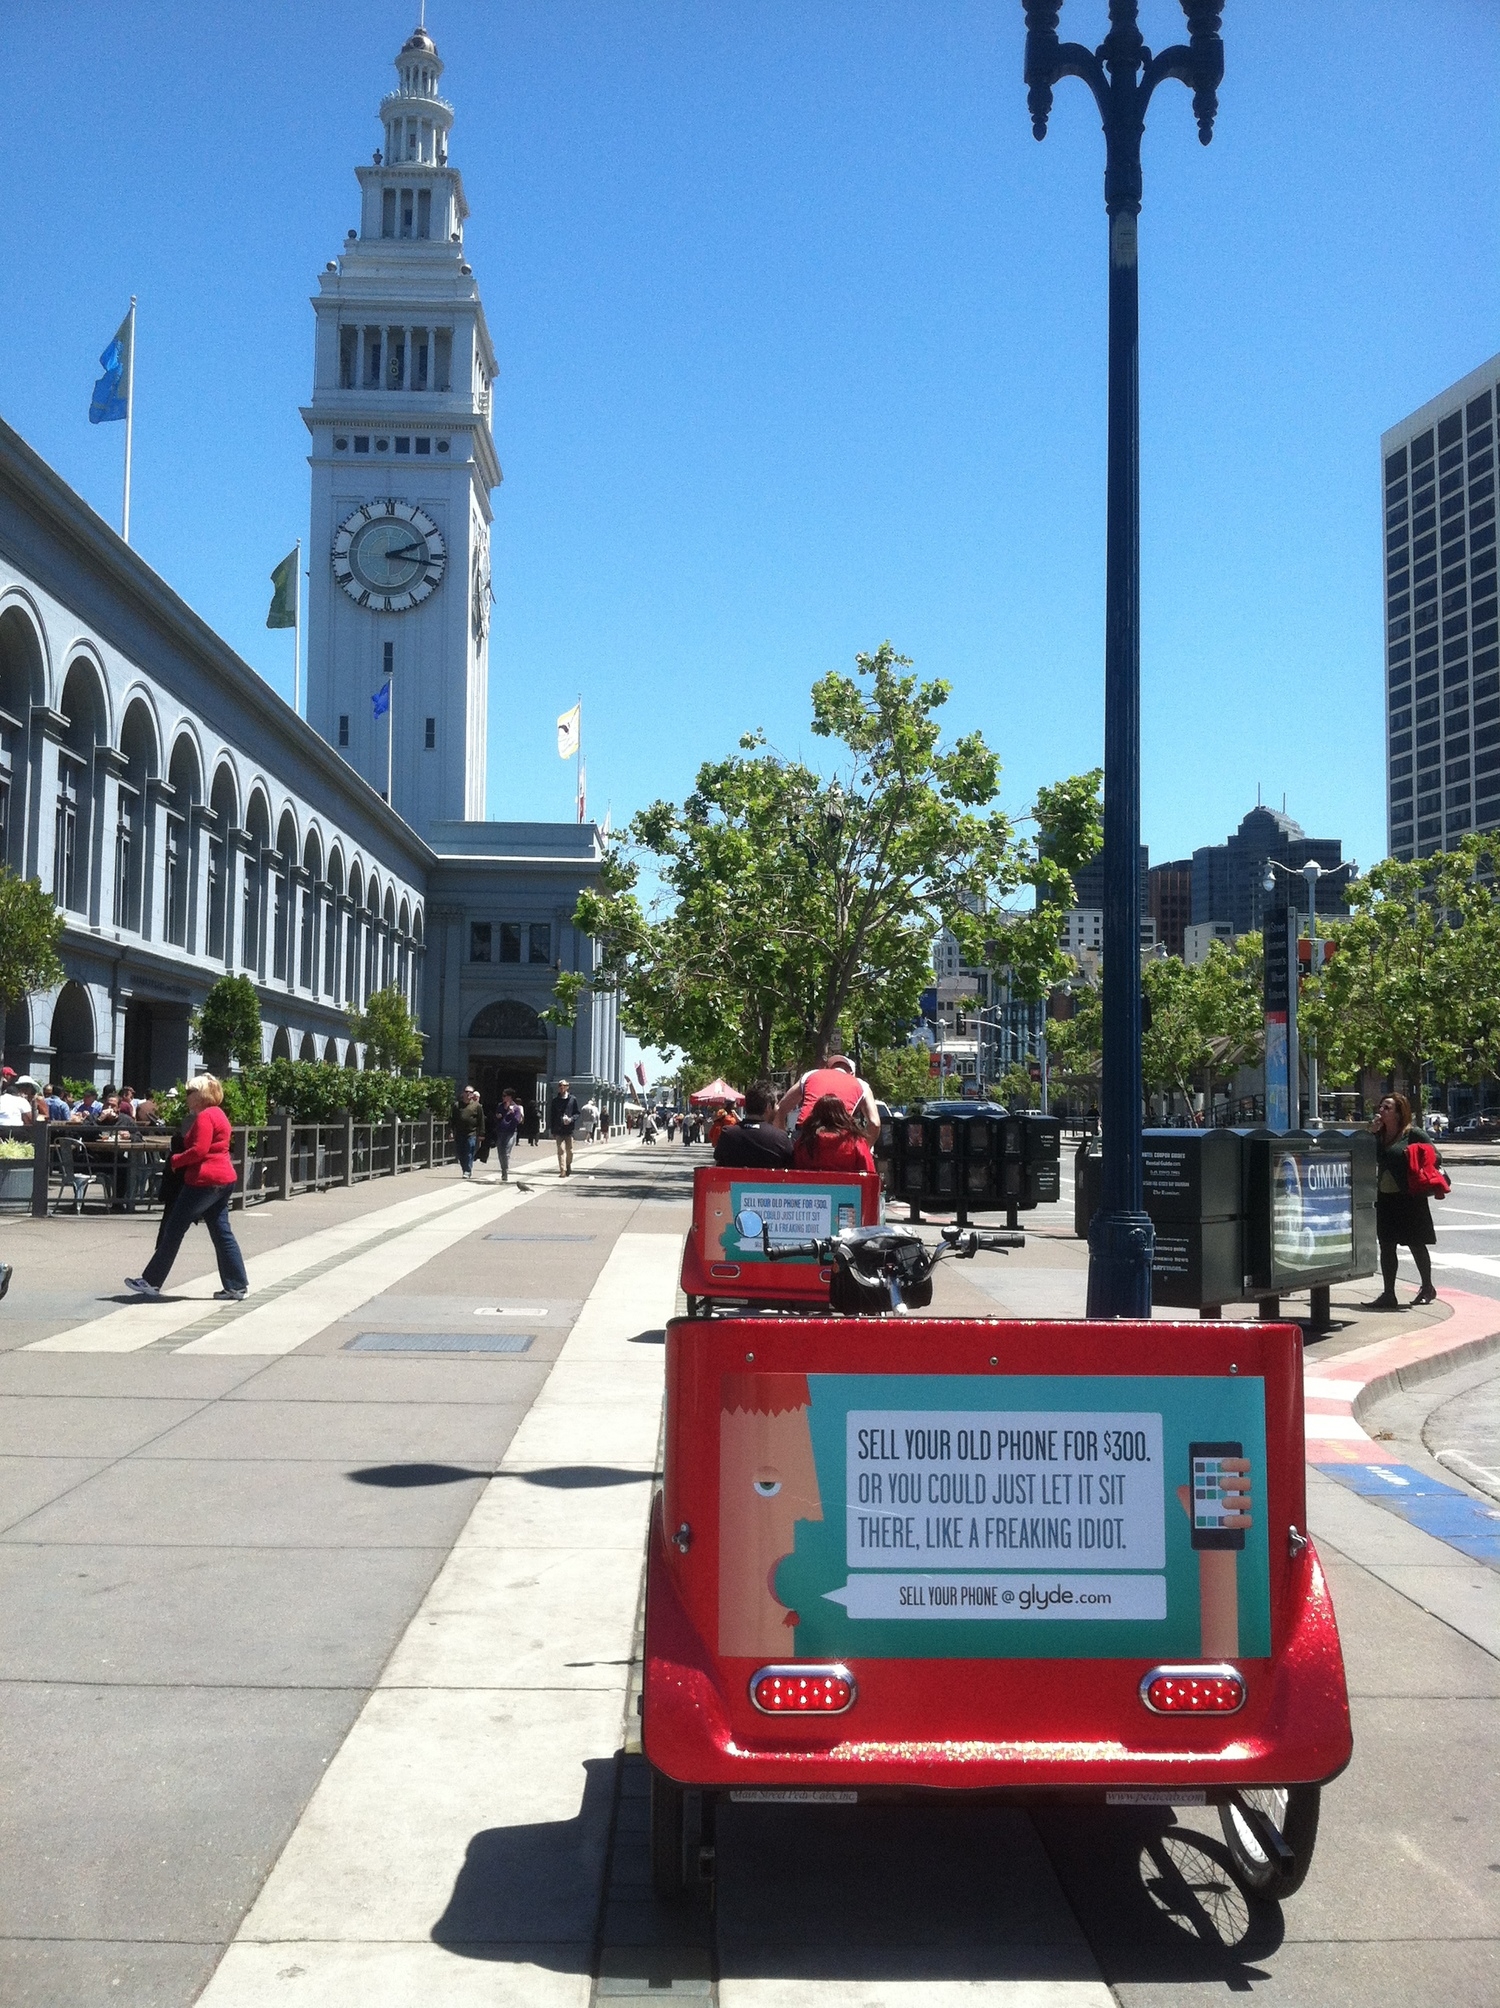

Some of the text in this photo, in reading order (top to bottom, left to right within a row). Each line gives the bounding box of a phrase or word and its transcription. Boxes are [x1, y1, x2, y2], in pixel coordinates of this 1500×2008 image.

[1308, 1164, 1348, 1191] GIMME
[744, 1198, 756, 1208] SELL
[757, 1198, 772, 1208] YOUR
[772, 1199, 782, 1208] OLD
[783, 1199, 801, 1208] PHONE
[802, 1199, 812, 1209] FOR
[764, 1211, 781, 1220] COULD
[781, 1211, 795, 1221] JUST
[796, 1211, 805, 1221] LET
[806, 1212, 811, 1221] IT
[812, 1212, 820, 1221] SIT
[779, 1223, 805, 1233] FREAKING
[858, 1429, 1151, 1462] SELL YOUR OLD PHONE FOR $300.
[858, 1473, 1126, 1505] OR YOU COULD JUST LET IT SIT
[858, 1516, 1127, 1551] THERE, LIKE A FREAKING IDIOT.
[899, 1583, 1112, 1610] SELL YOUR PHONE @ glyde.com
